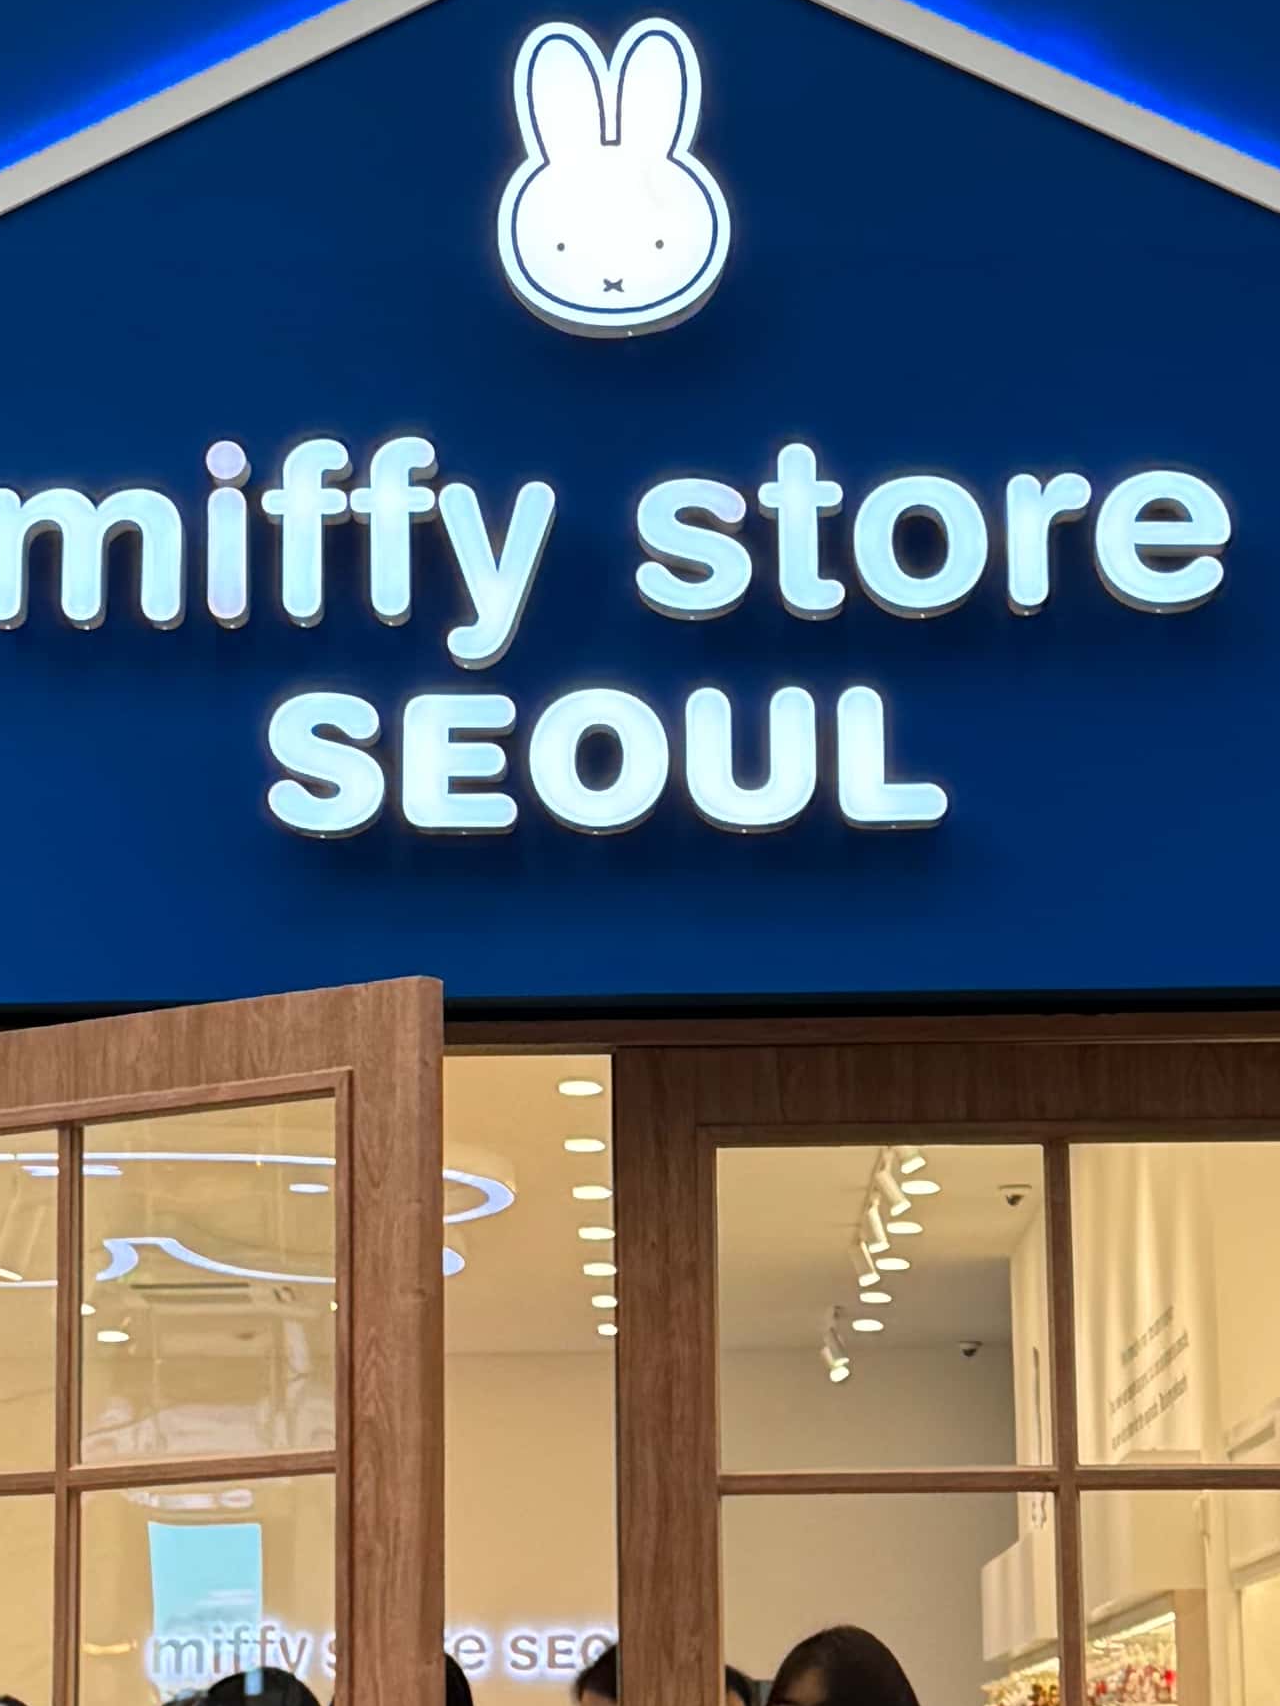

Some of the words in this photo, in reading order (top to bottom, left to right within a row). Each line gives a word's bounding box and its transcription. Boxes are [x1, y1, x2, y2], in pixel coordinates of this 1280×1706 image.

[636, 443, 1232, 619] store
[268, 686, 948, 837] SEOUL
[154, 1624, 308, 1675] miffy
